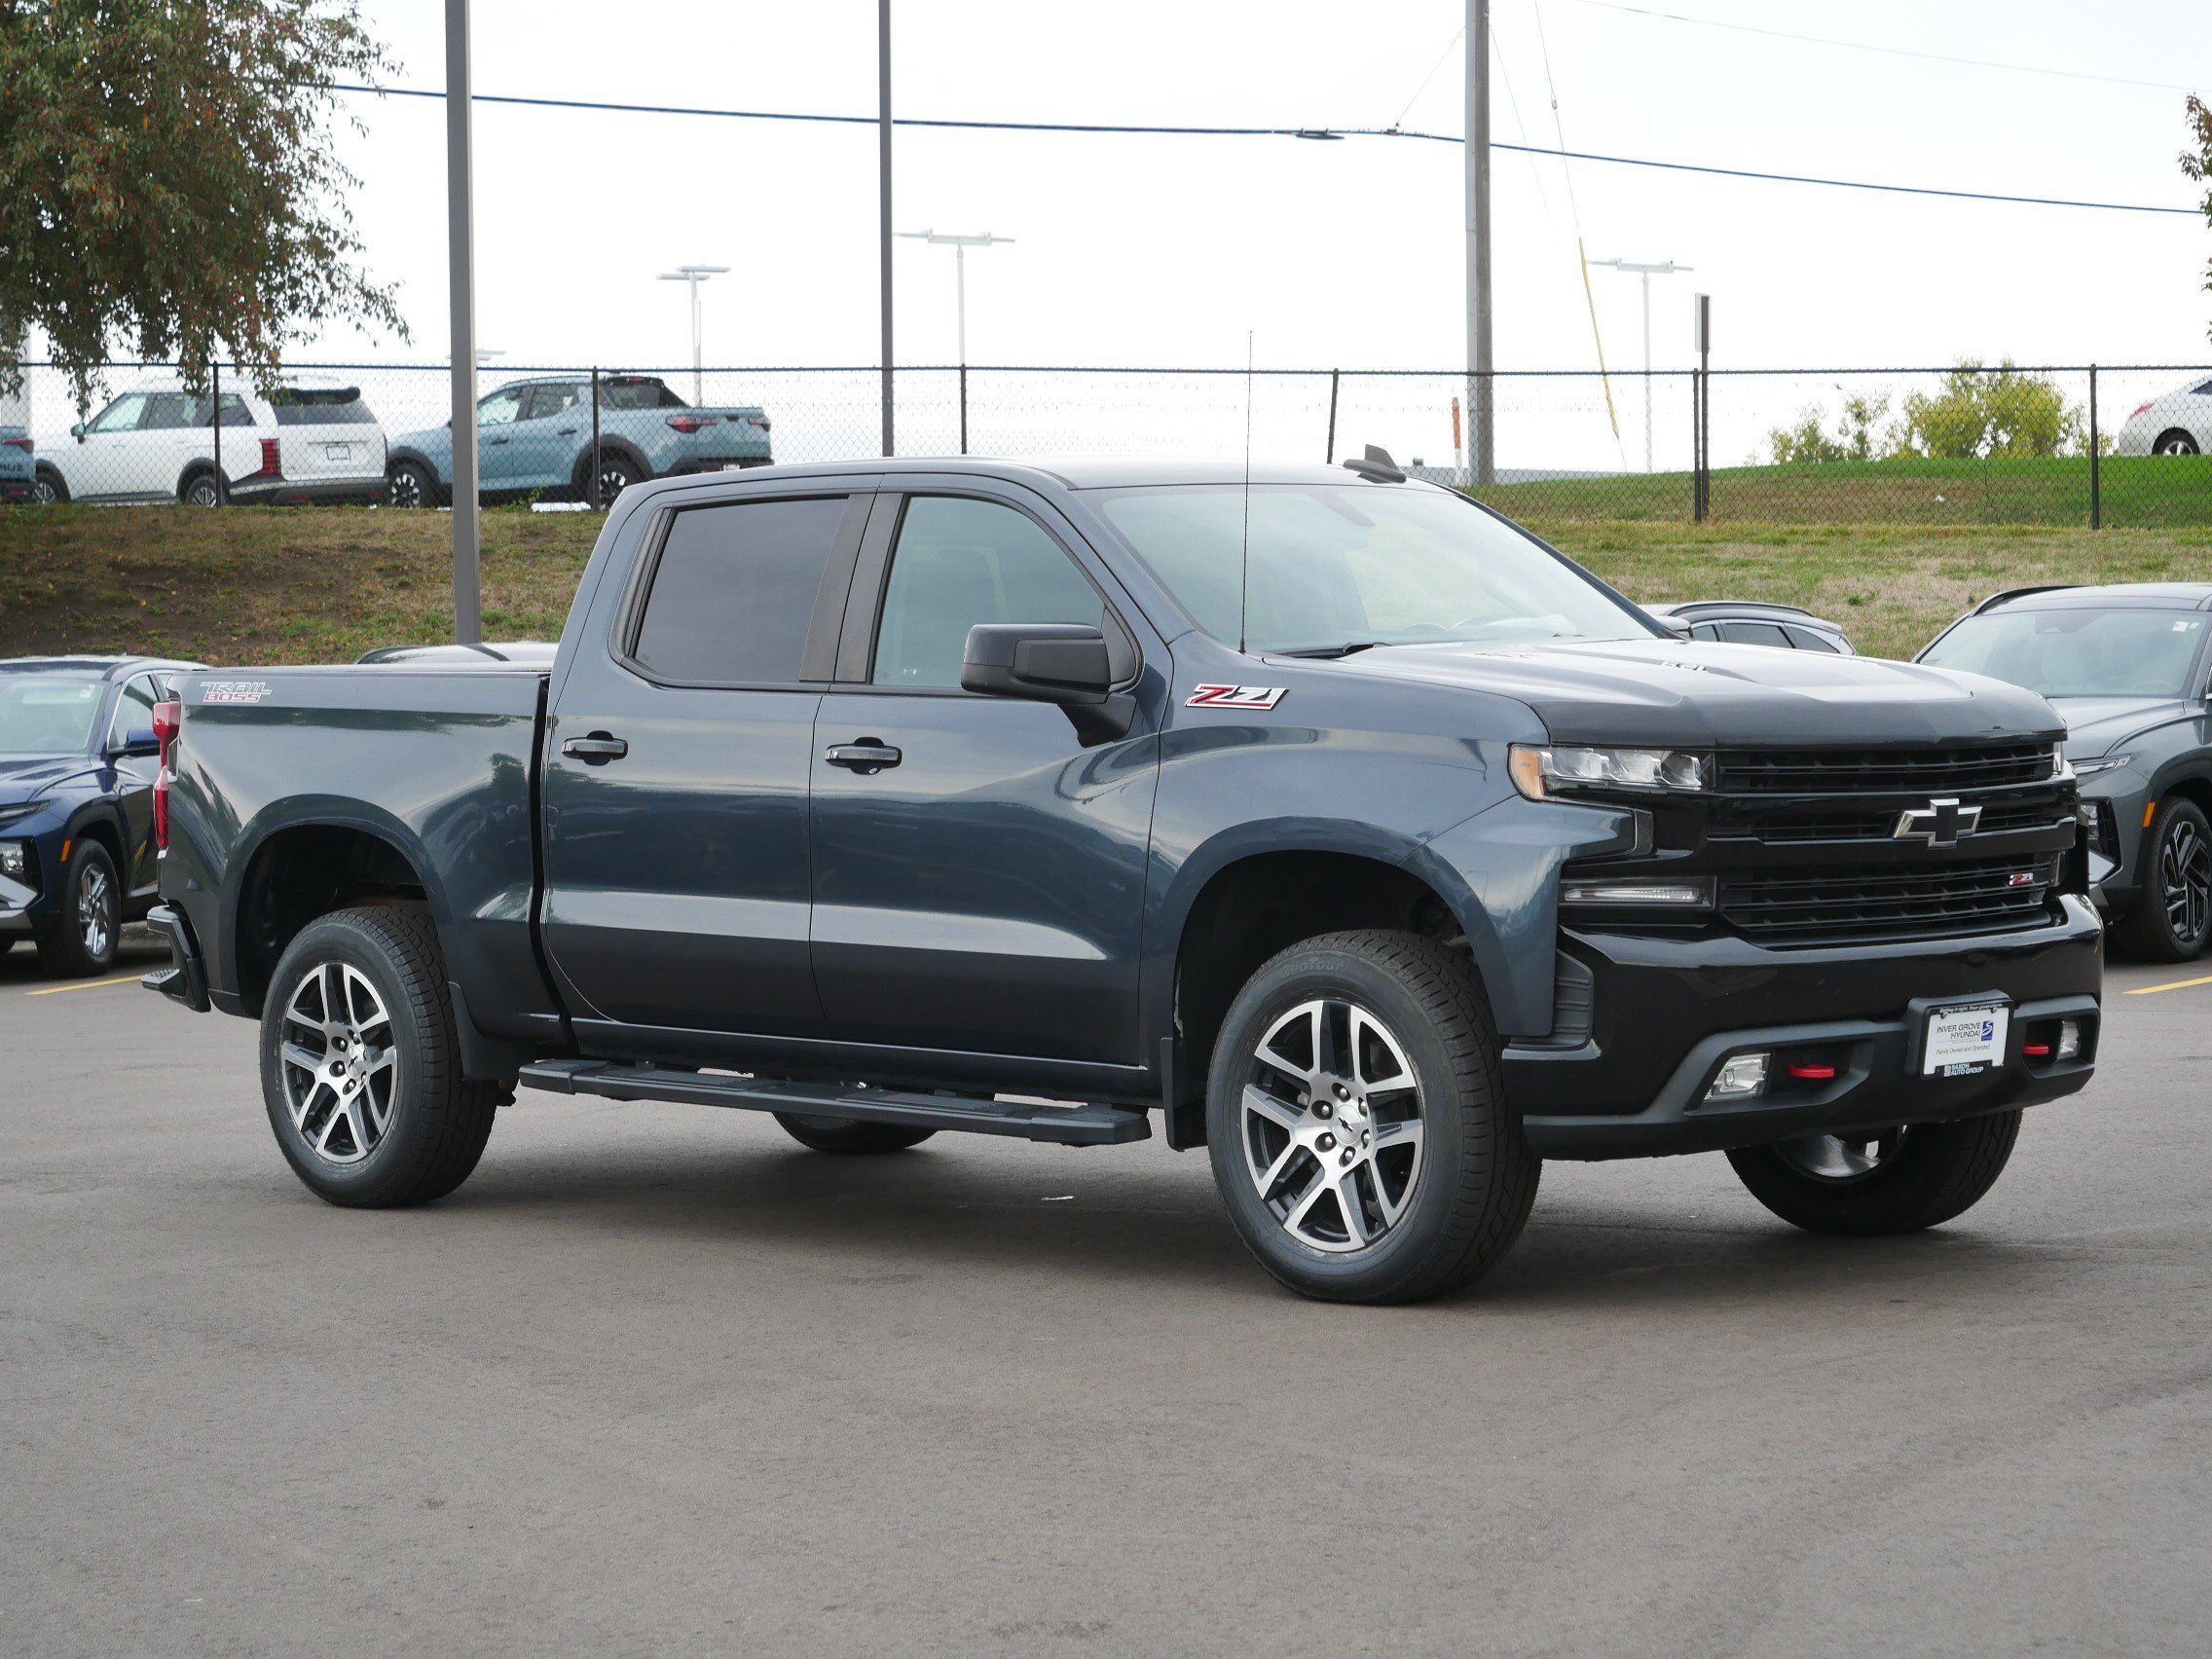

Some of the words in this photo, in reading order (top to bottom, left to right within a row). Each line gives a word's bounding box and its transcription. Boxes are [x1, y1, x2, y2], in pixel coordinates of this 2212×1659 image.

[200, 682, 273, 694] TRAIL
[203, 692, 261, 703] BOSS
[1184, 682, 1289, 711] Z71
[1936, 1024, 1957, 1033] INVER
[1958, 1021, 1981, 1031] GROVE
[1950, 1030, 1981, 1039] HYUNDAI
[1966, 1066, 1984, 1075] GROUP
